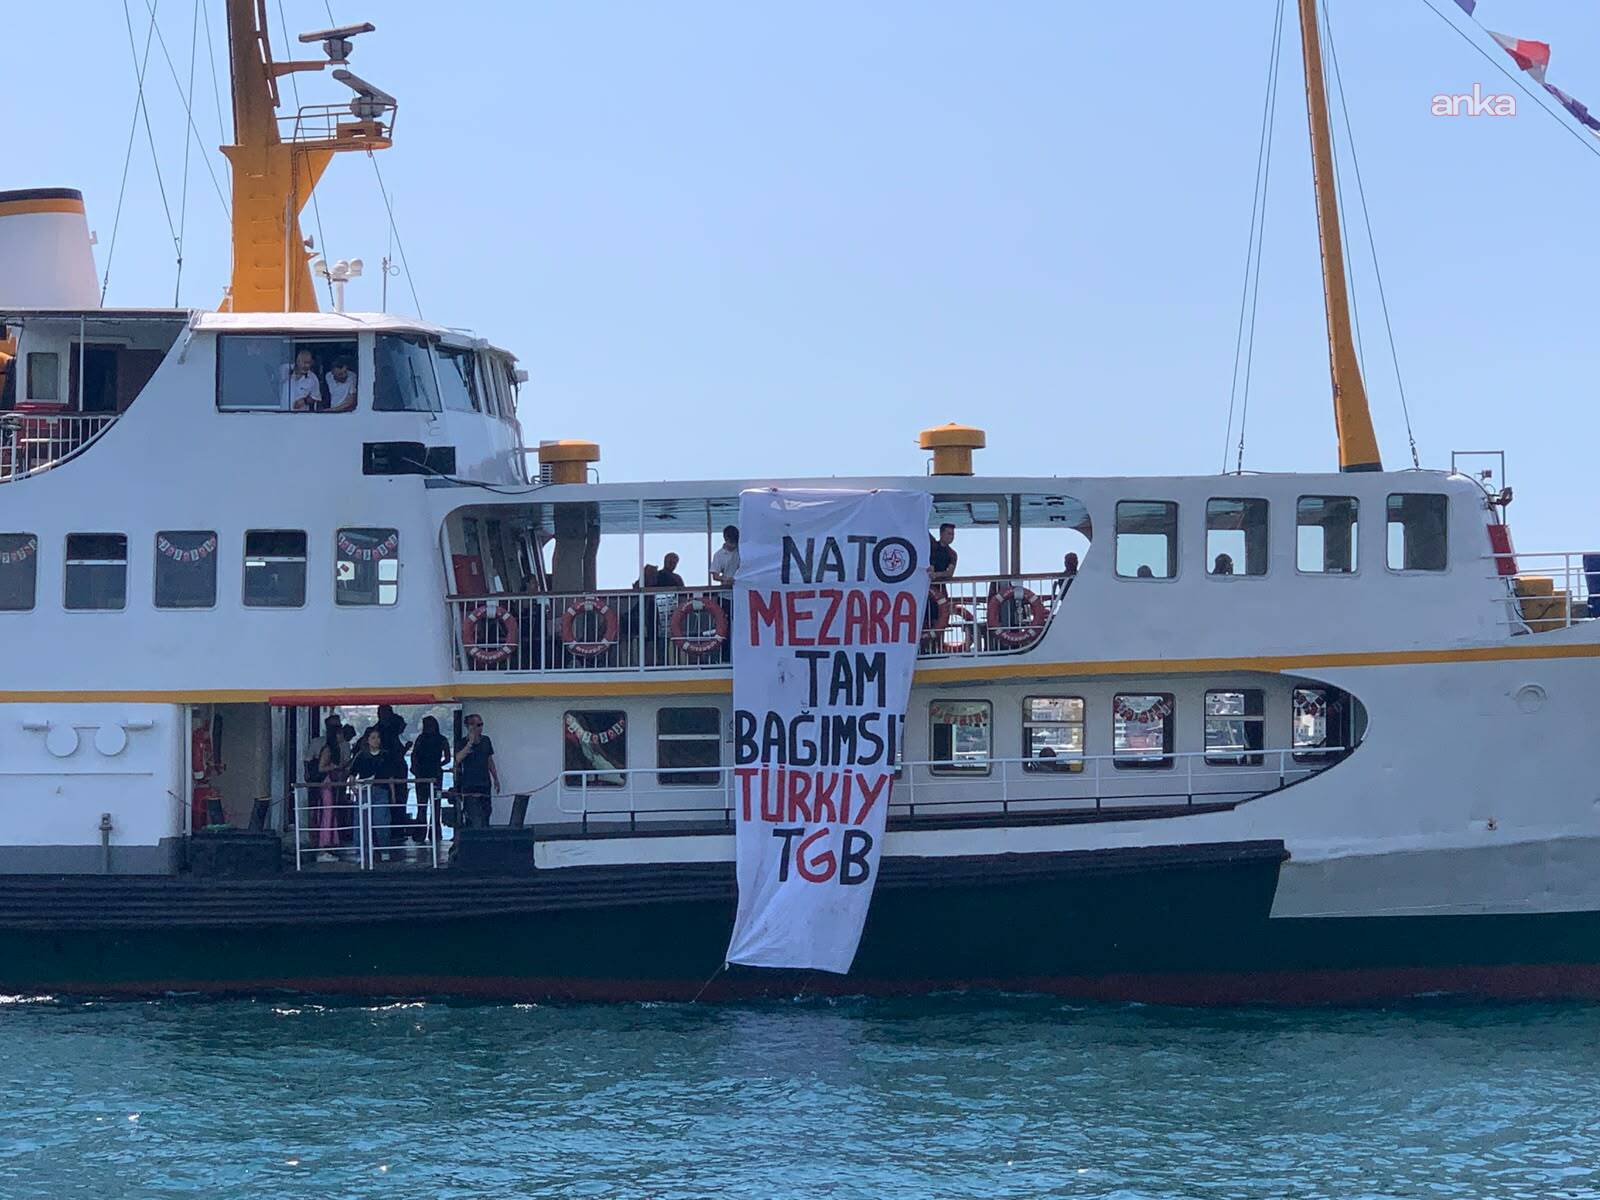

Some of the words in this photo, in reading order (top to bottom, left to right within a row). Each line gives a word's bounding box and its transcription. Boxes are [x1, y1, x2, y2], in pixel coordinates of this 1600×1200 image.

[781, 535, 917, 585] NATO
[749, 588, 917, 648] MEZARA
[795, 650, 886, 708] TAM
[735, 709, 906, 767] BAĞIMSI
[735, 764, 895, 825] TÜRKİY
[773, 827, 873, 885] TGB
